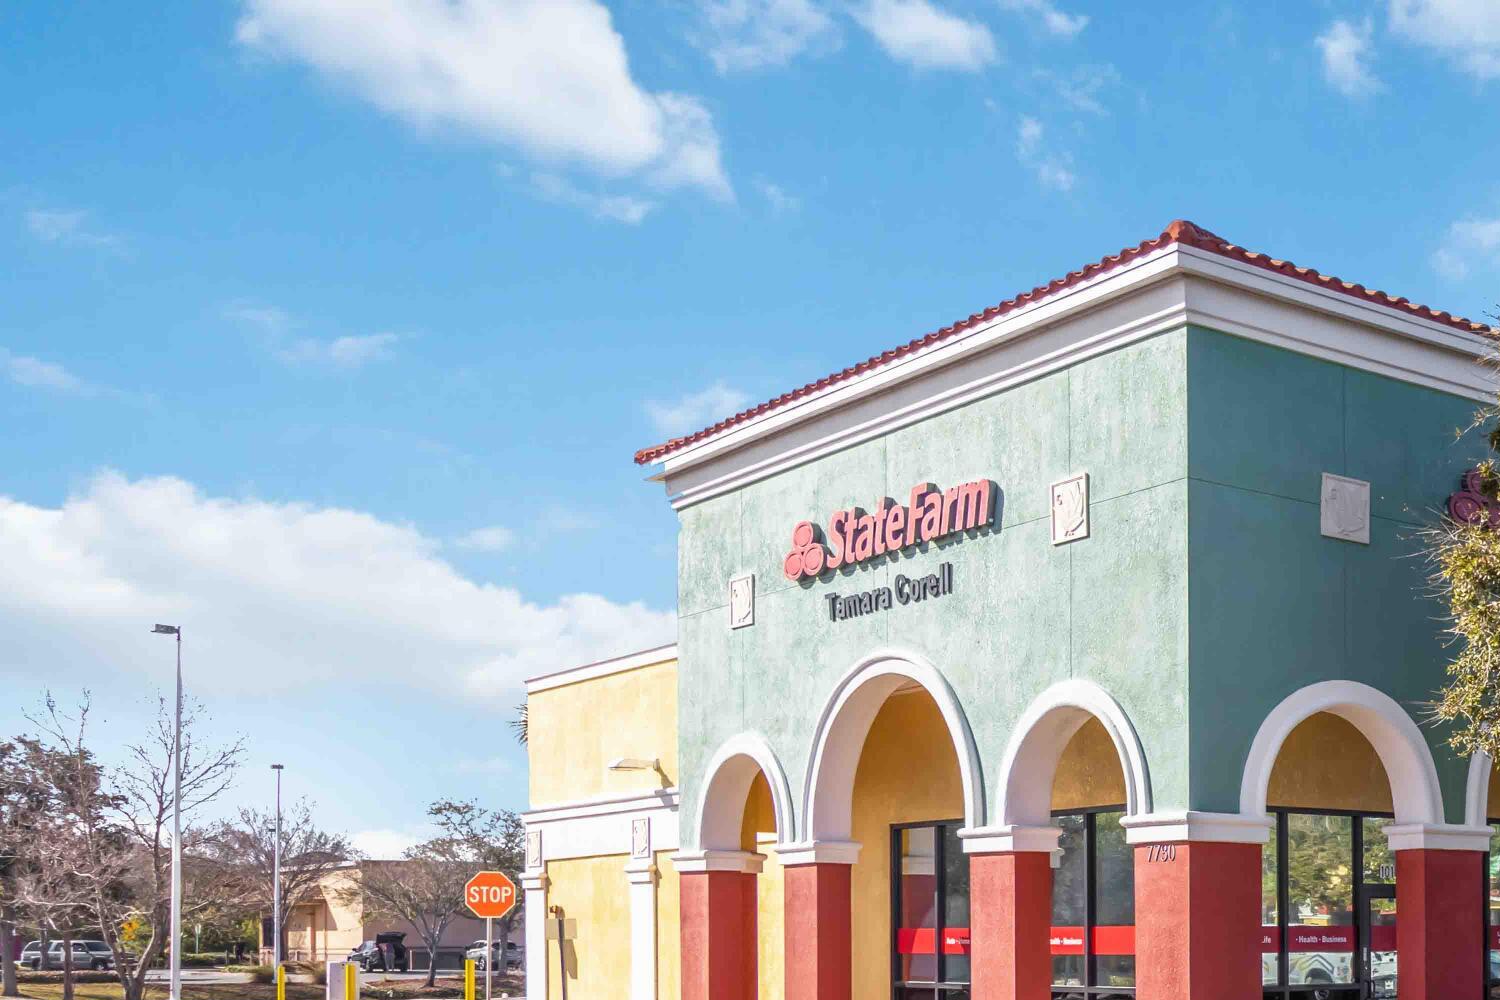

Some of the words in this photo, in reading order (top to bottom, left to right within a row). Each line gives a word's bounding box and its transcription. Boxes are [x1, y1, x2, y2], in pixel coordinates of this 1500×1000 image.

[825, 587, 893, 622] Tamara
[895, 562, 954, 606] Corell
[469, 886, 512, 904] STOP
[1298, 935, 1318, 944] Health
[1322, 935, 1347, 943] Business
